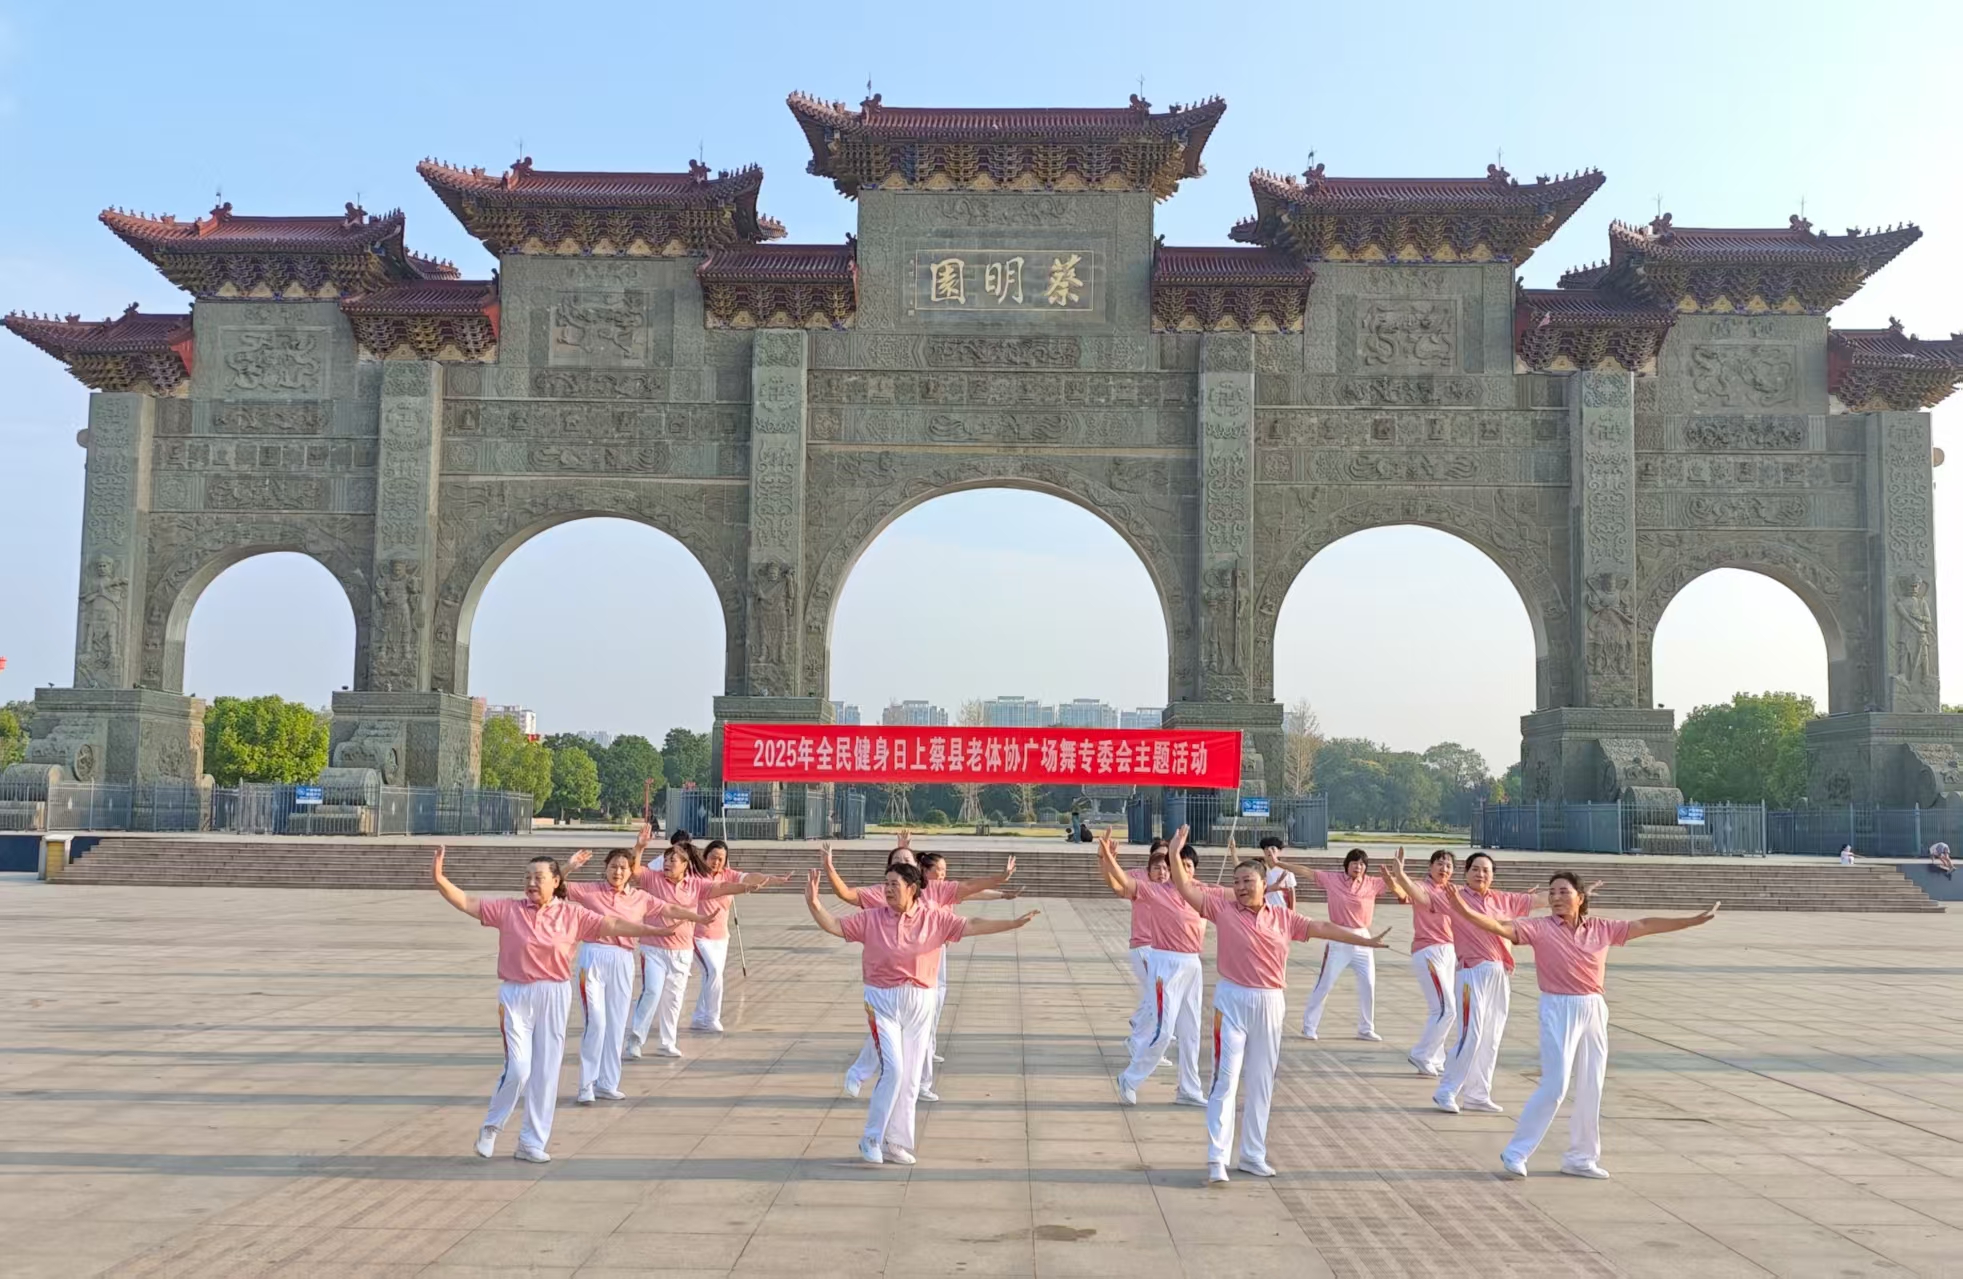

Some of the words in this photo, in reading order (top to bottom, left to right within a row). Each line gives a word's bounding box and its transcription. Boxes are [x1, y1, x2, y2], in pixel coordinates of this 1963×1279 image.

[753, 735, 1208, 776] 2025年全民健身日上蔡县老体协广场舞专委会主题活动
